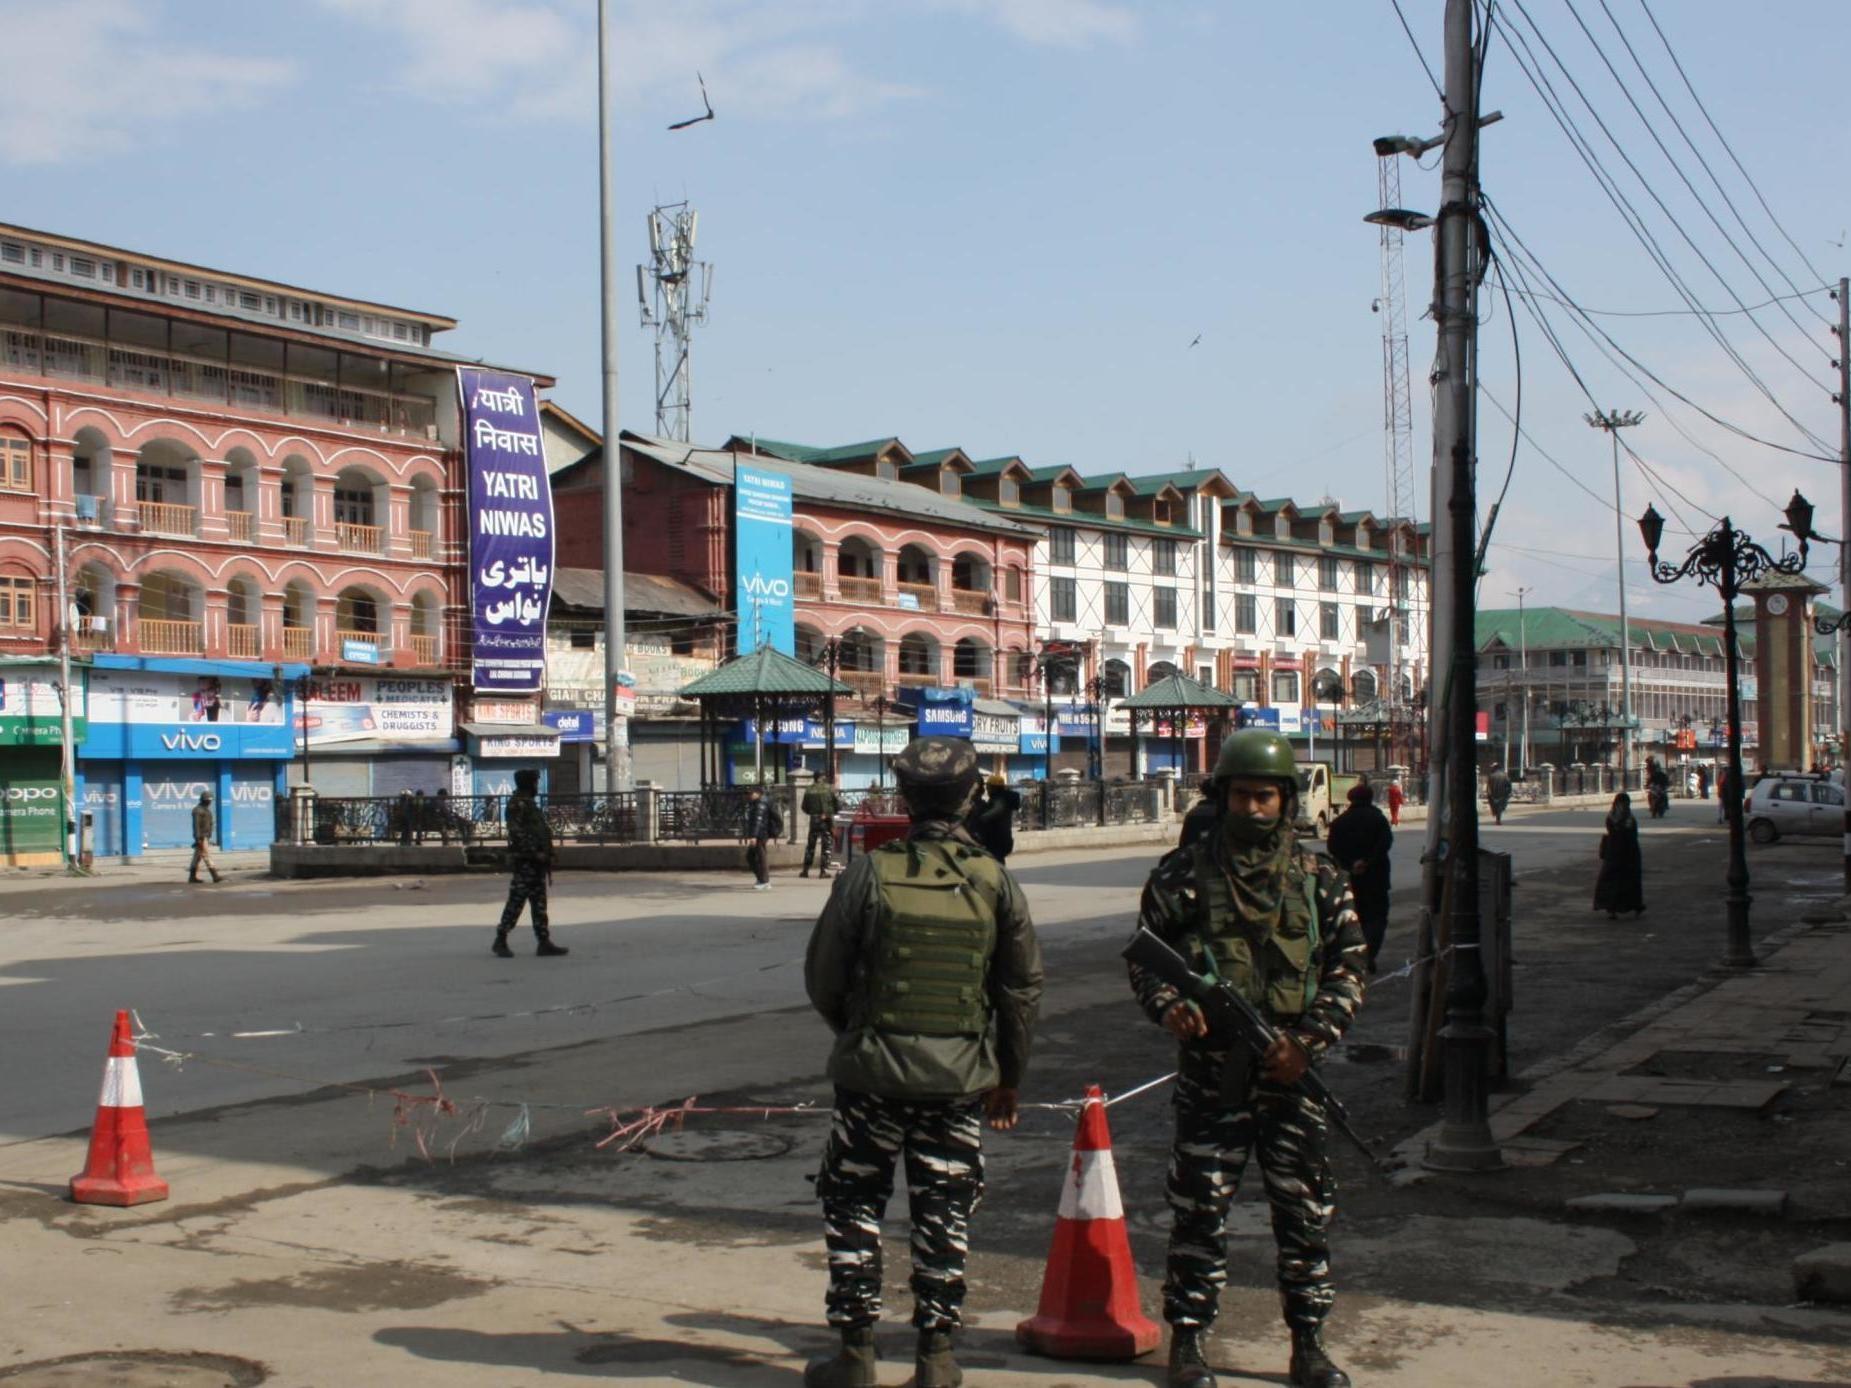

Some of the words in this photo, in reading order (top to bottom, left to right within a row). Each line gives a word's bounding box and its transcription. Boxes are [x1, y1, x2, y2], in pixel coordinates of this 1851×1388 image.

[474, 419, 538, 455] निवास
[482, 471, 539, 500] YATRI
[480, 509, 546, 538] NIWAS
[743, 573, 789, 597] vivo
[377, 680, 446, 694] PEOPLES
[381, 710, 428, 719] CHEMISTS
[432, 711, 439, 720] &
[925, 708, 968, 723] SAMSUNG
[382, 722, 437, 730] DRUGGISTS
[990, 719, 1018, 734] FRUITS
[161, 728, 222, 751] vivo
[83, 789, 117, 803] vivo
[230, 781, 272, 802] vivo
